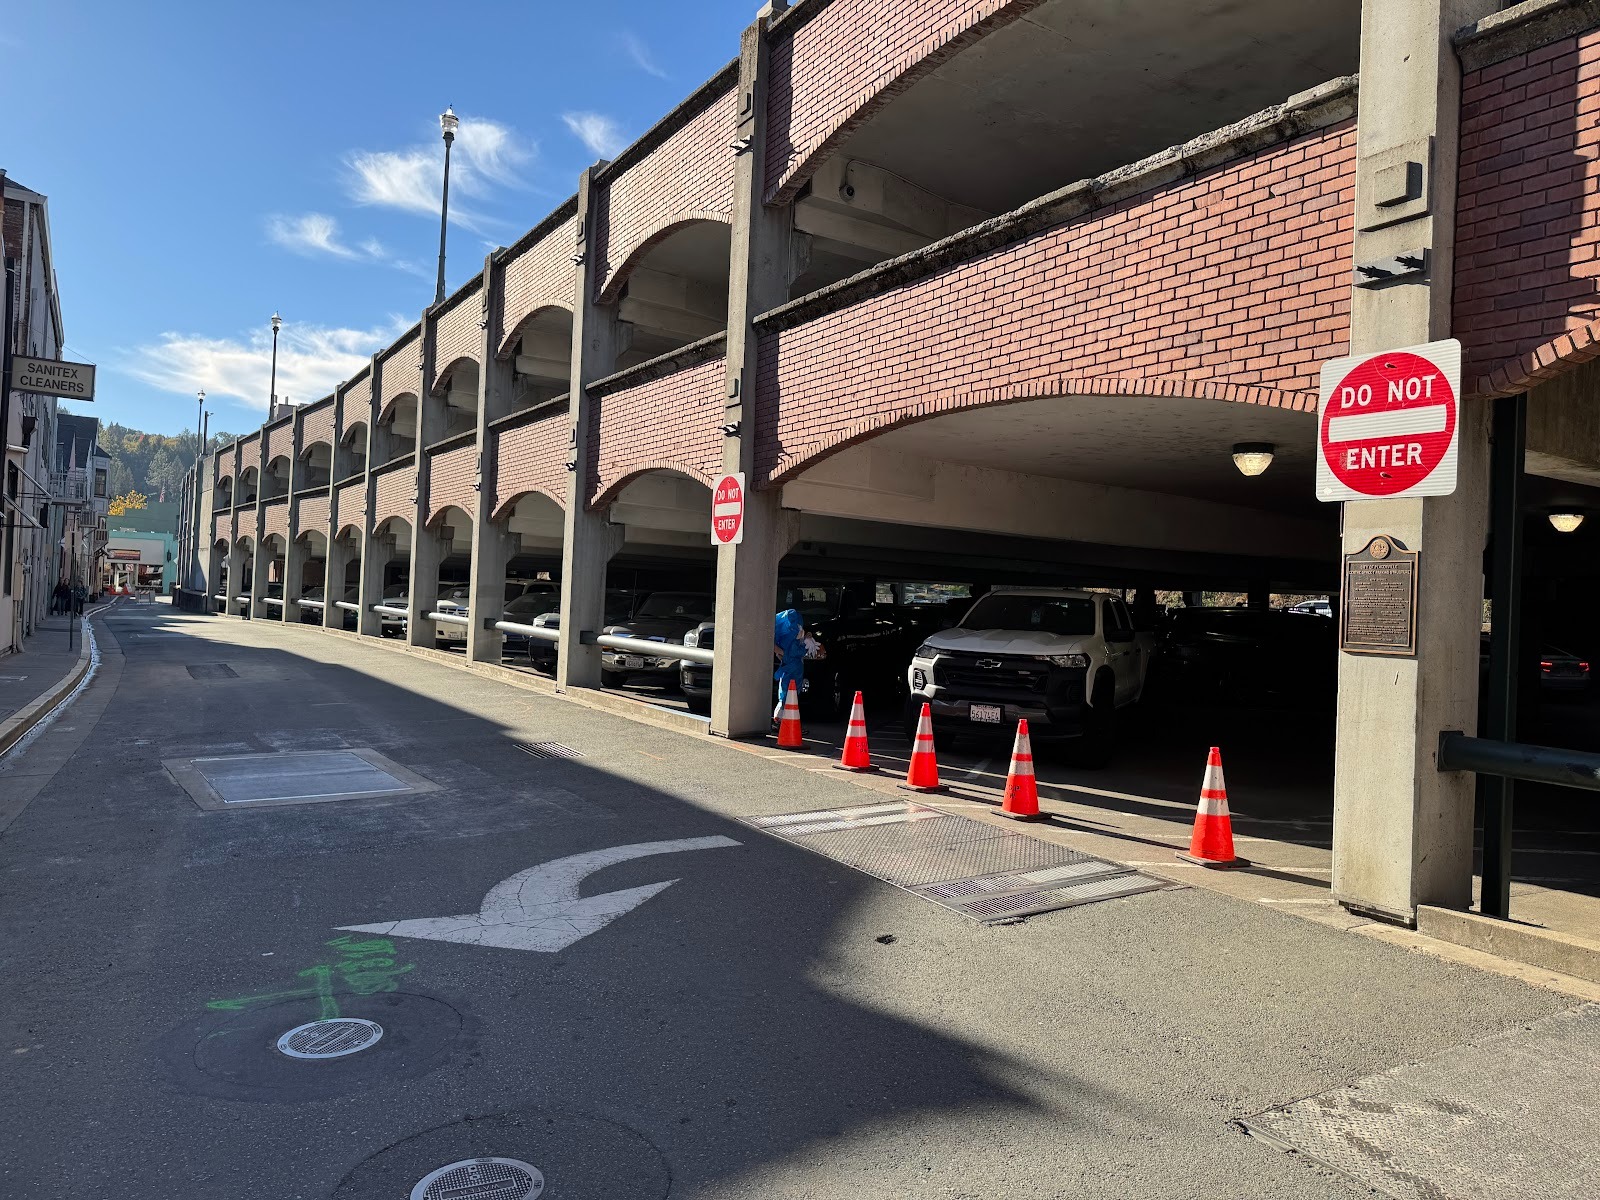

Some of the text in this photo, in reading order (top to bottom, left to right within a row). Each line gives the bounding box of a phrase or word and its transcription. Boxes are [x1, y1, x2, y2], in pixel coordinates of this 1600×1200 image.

[27, 362, 78, 379] SANITEX
[20, 375, 84, 393] CLEANERS
[1341, 375, 1436, 409] DO NOT
[1346, 443, 1422, 470] ENTER
[717, 487, 739, 501] DO NOT
[718, 518, 735, 531] ENTER
[459, 1183, 500, 1195] WATER
